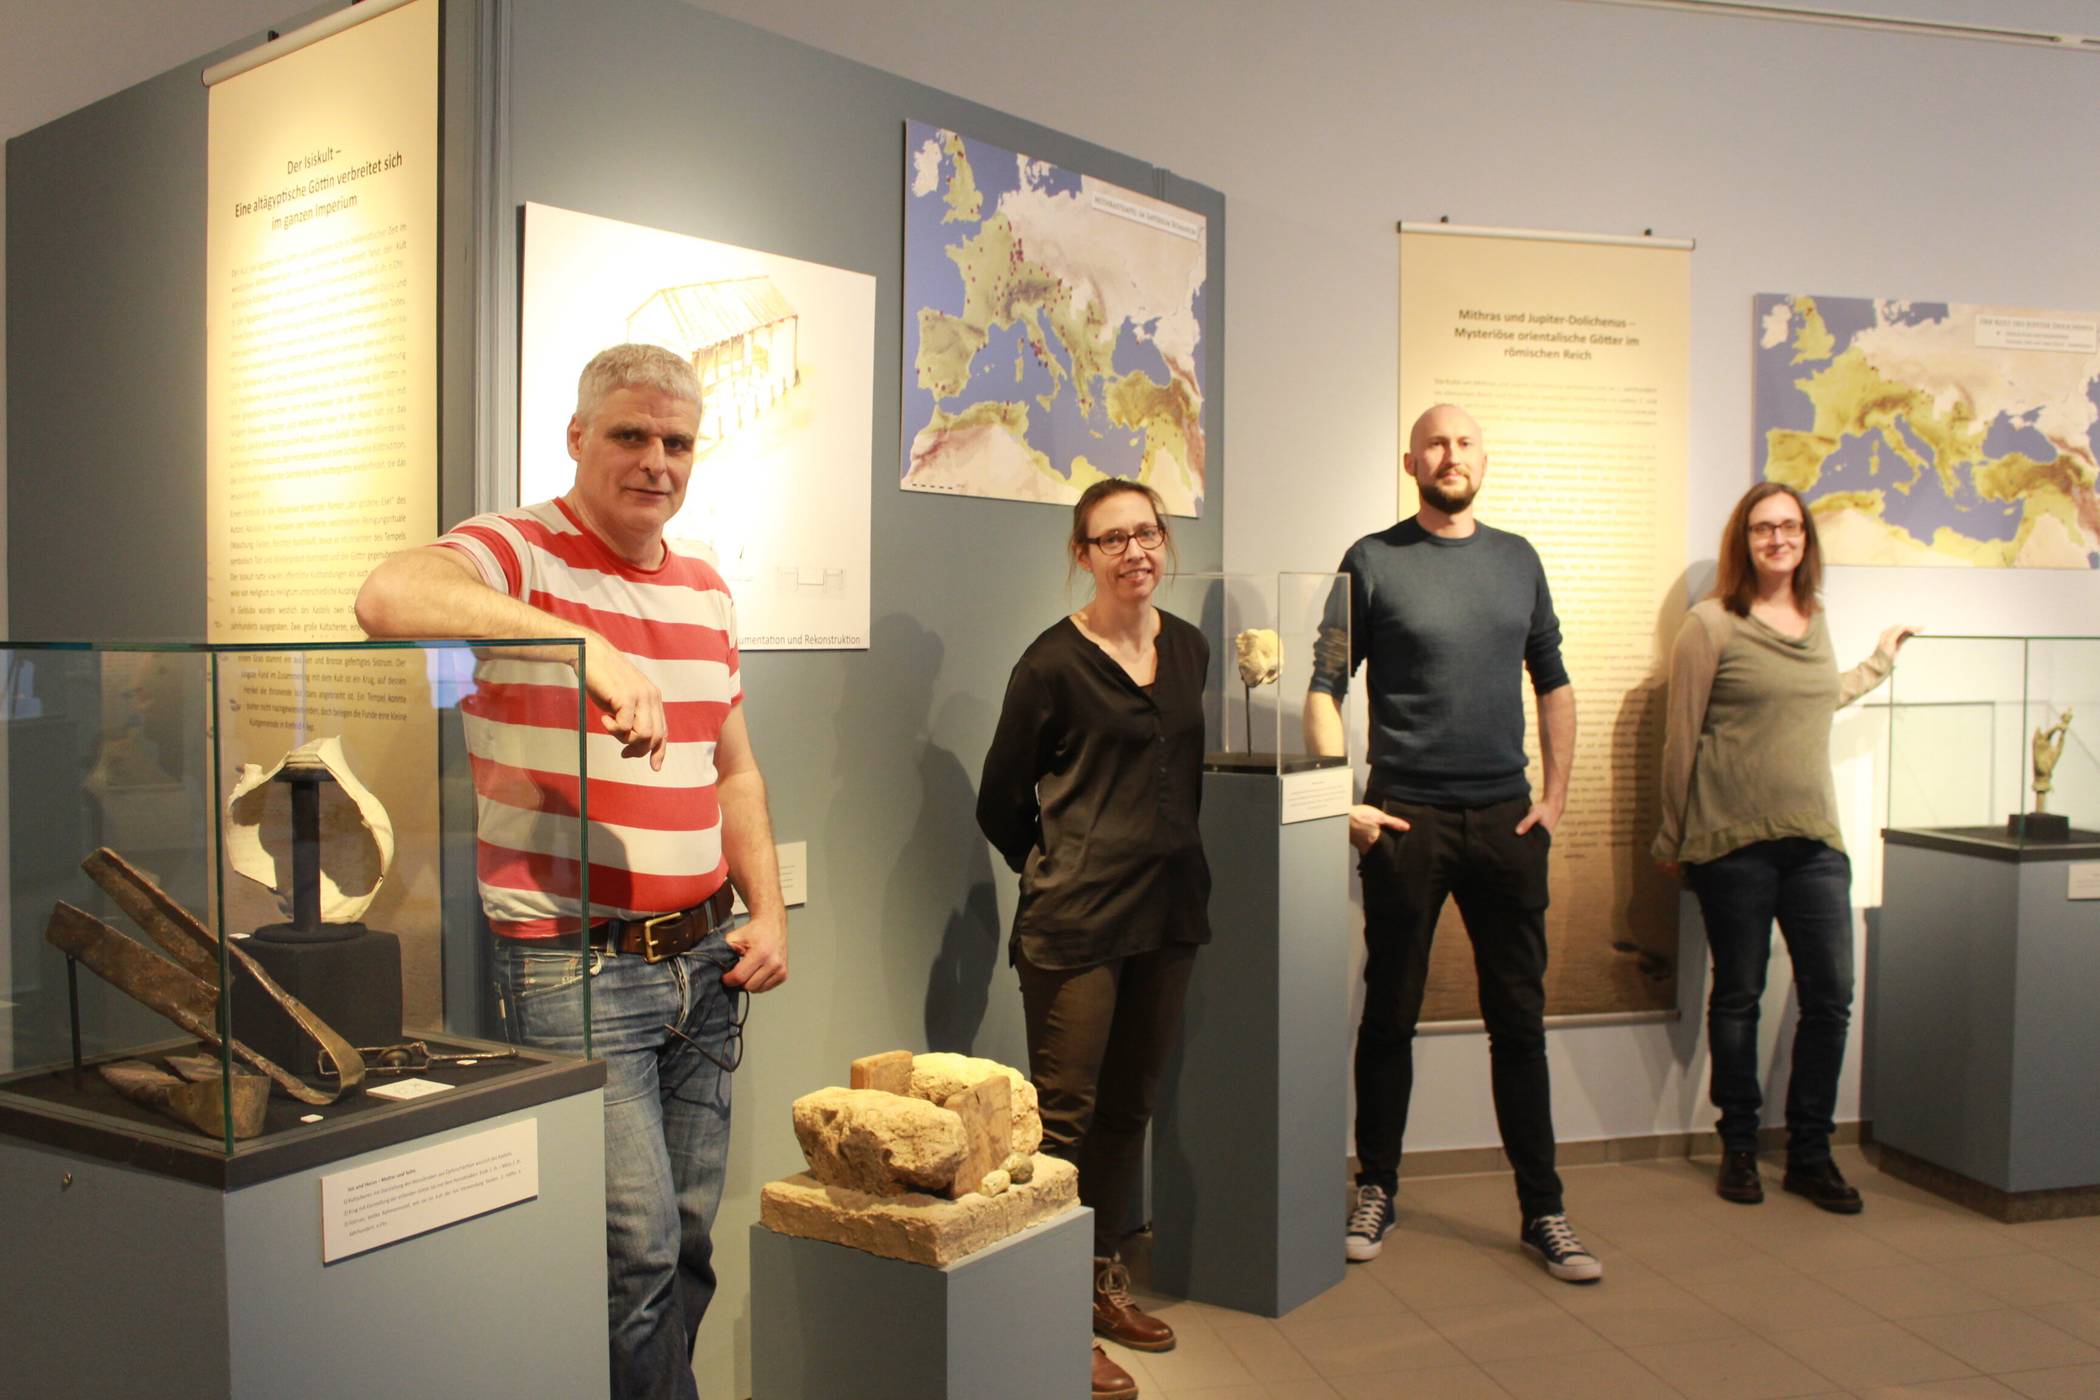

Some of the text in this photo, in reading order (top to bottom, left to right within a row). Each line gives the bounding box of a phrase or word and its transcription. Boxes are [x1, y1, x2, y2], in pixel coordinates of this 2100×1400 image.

[287, 160, 302, 175] Der
[304, 146, 333, 169] Isiskult
[234, 150, 402, 218] Eine altägyptische Göttin verbreitet sich
[271, 194, 358, 231] im ganzen Imperium
[1459, 308, 1501, 321] Mithras
[1503, 313, 1525, 323] und
[1528, 313, 1627, 328] Jupiter-Dolichenus
[1454, 327, 1640, 347] Mysteriöse orientalische Götter im
[1503, 346, 1592, 361] römischen Reich
[739, 633, 861, 646] umentation und Rekonstruktion
